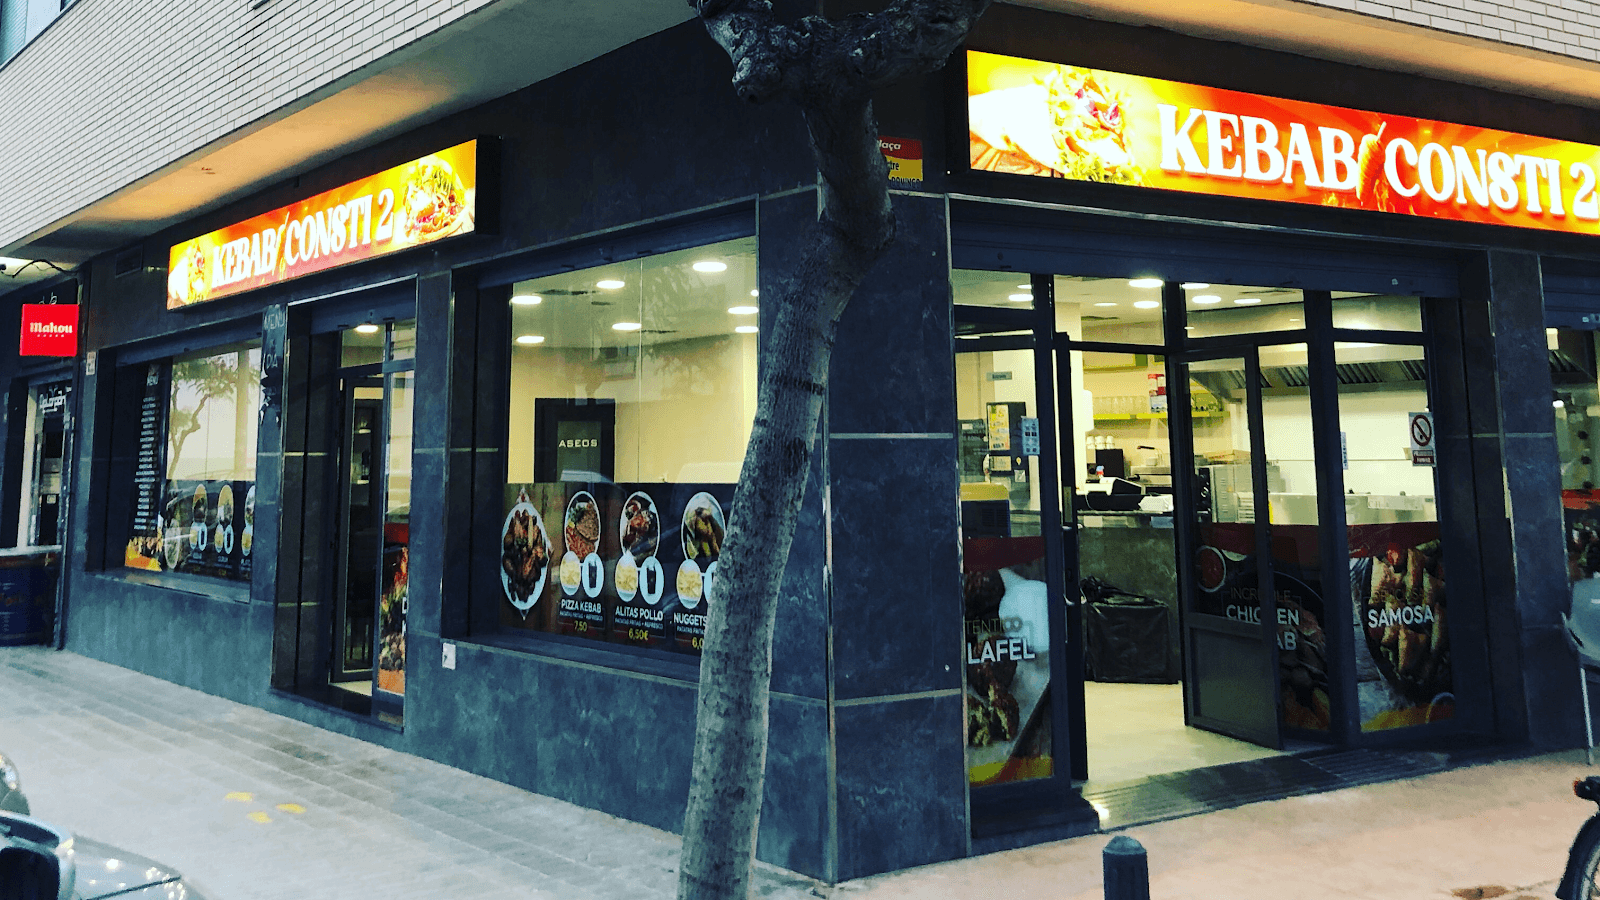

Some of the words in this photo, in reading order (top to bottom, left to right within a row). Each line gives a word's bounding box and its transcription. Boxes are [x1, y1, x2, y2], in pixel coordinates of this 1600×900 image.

[1157, 103, 1359, 190] KEBAB
[1569, 162, 1600, 219] 2
[211, 228, 277, 288] KEBAB
[375, 188, 394, 241] 2
[30, 322, 73, 334] Mahou
[558, 438, 598, 448] ASEOS
[561, 598, 579, 611] PIZZA
[580, 600, 602, 614] KEBAB
[615, 605, 639, 619] ALITAS
[639, 608, 664, 622] POLLO
[1226, 604, 1299, 625] CHICEN
[673, 612, 707, 627] NUGGETS
[1368, 604, 1434, 628] SAMOSA
[628, 627, 649, 641] 6,50€
[967, 637, 1035, 664] LAFEL
